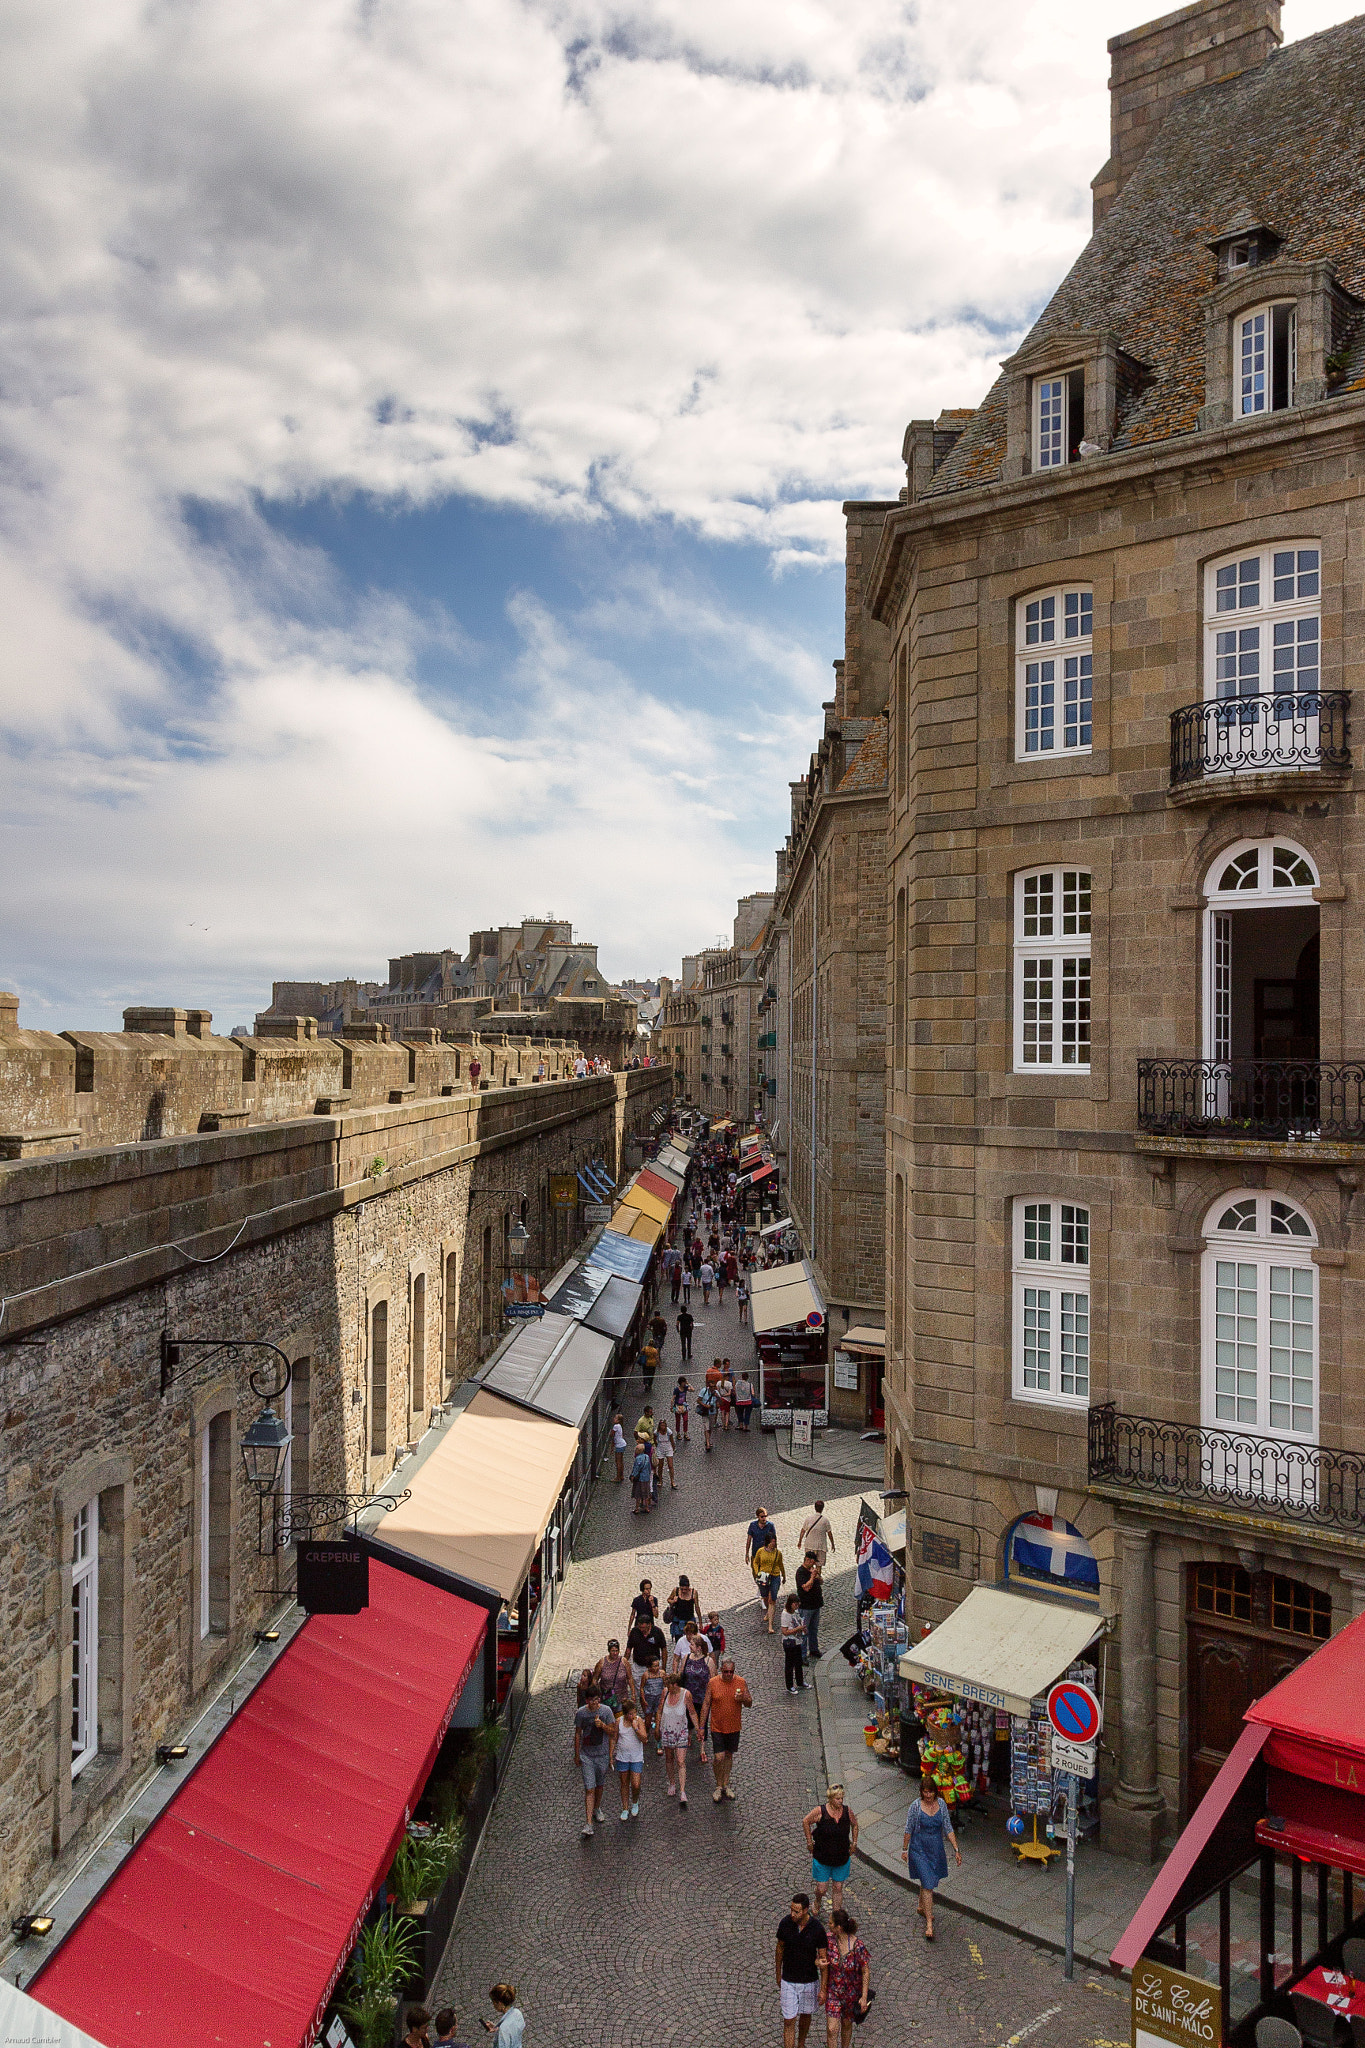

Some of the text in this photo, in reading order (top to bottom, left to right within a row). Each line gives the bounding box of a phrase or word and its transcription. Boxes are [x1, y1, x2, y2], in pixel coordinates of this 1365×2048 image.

[1055, 1757, 1089, 1775] 2 ROUES
[1334, 1760, 1359, 1788] LA
[1136, 1973, 1214, 2021] Le Café
[1135, 1996, 1149, 2015] DE
[1150, 2002, 1214, 2040] SAINT-MALO
